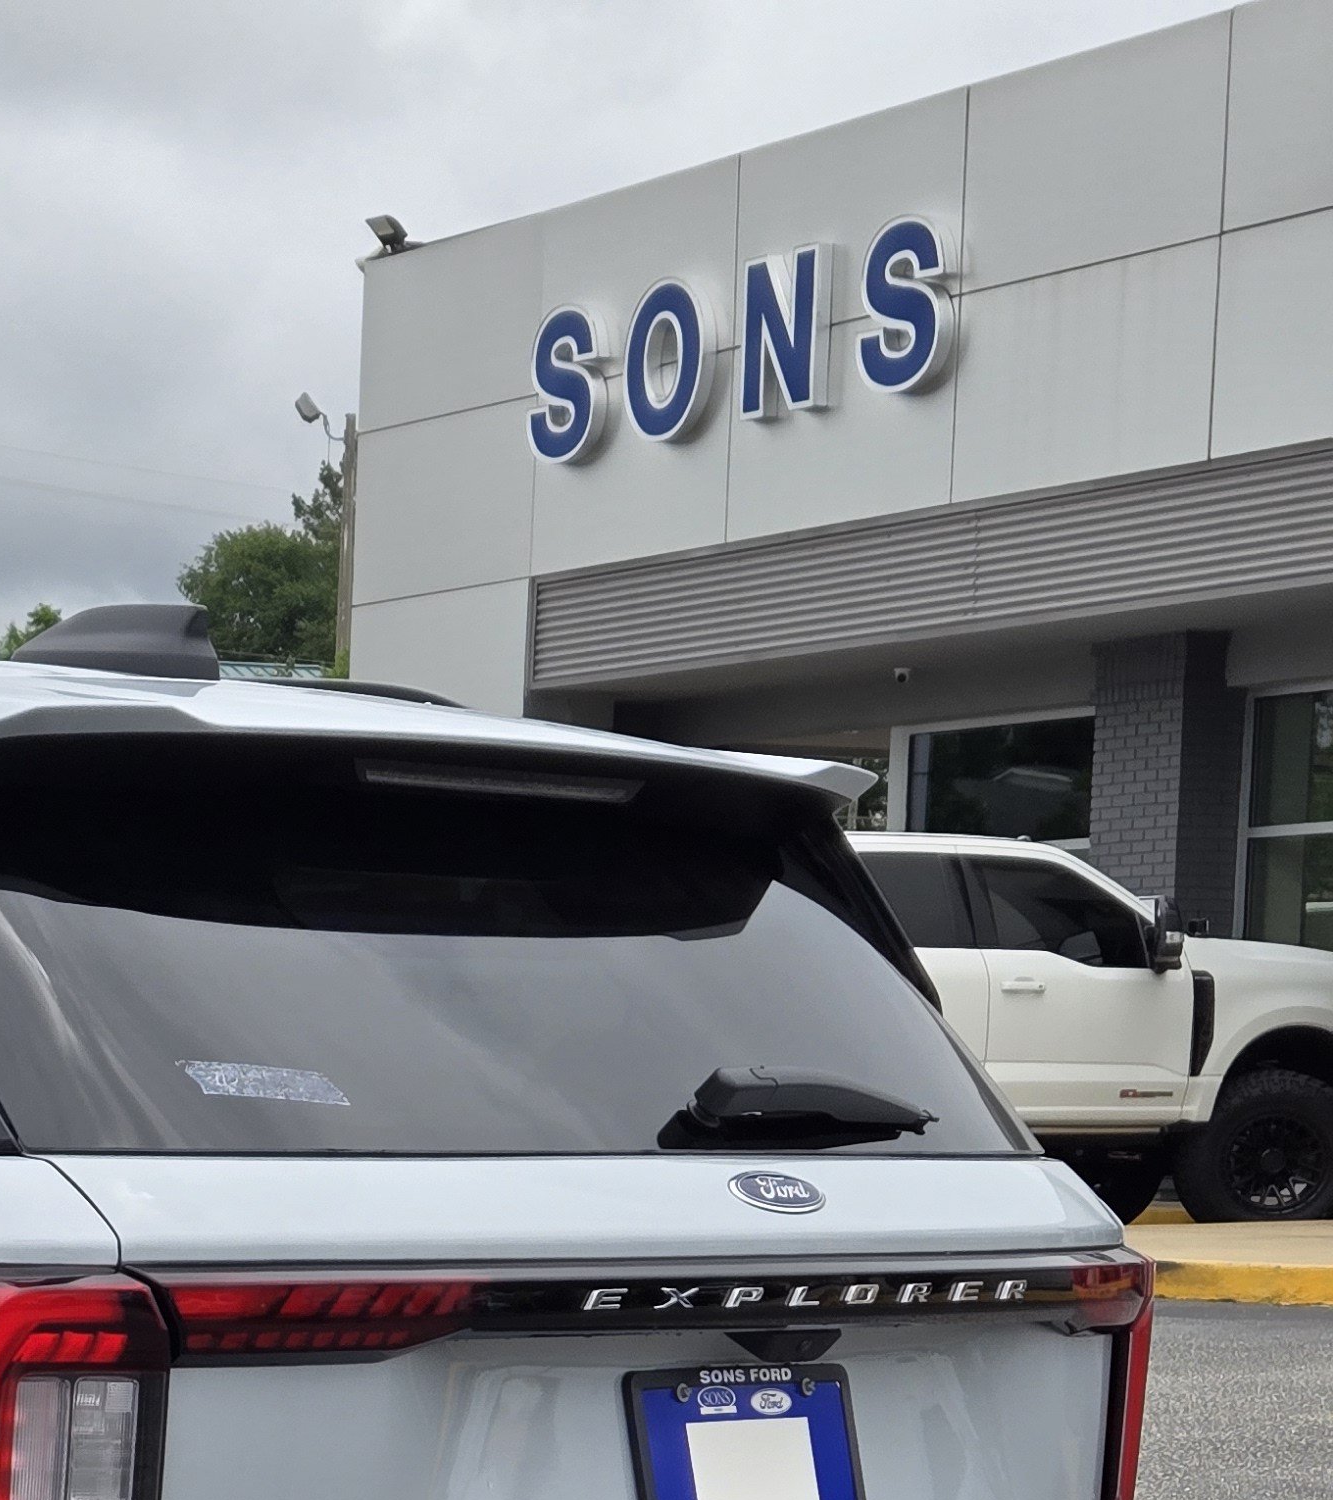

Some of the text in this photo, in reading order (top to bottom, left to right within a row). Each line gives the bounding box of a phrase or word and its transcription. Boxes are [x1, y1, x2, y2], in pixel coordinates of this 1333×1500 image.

[527, 214, 953, 464] SONS
[755, 1175, 811, 1199] Ford
[582, 1278, 1029, 1311] EXPLORER
[699, 1367, 792, 1384] SONS FORD
[759, 1392, 784, 1409] Ford
